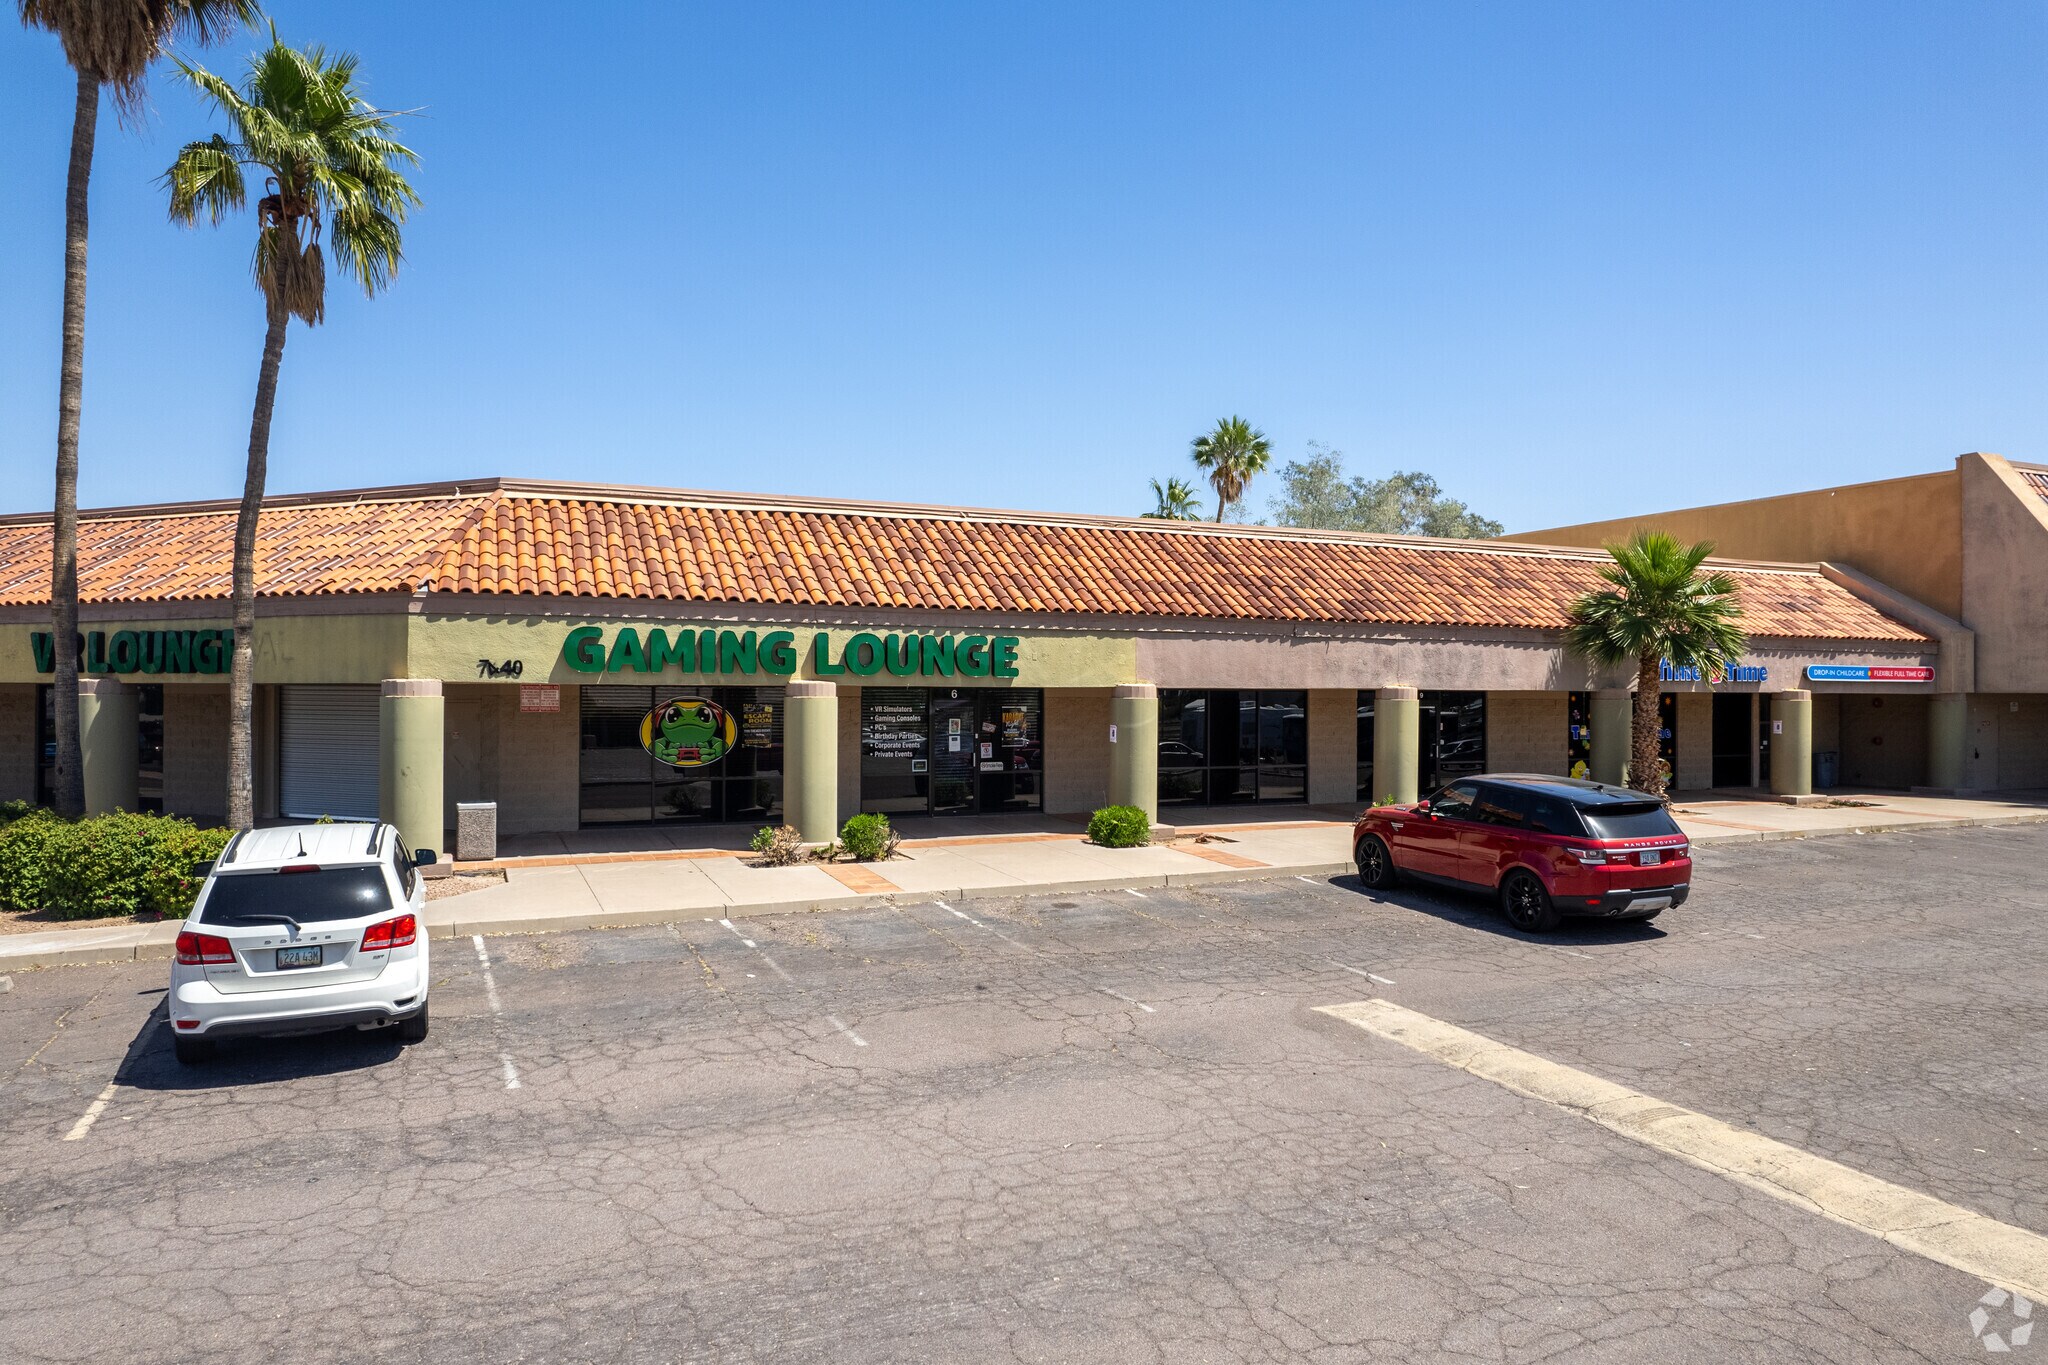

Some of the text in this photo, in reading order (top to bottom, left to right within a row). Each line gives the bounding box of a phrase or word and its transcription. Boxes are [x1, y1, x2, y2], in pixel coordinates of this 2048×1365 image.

[31, 631, 85, 674] V
[563, 626, 1020, 678] GAMING LOUNGE
[1836, 669, 1865, 677] CHILDCARE
[951, 689, 958, 699] 6
